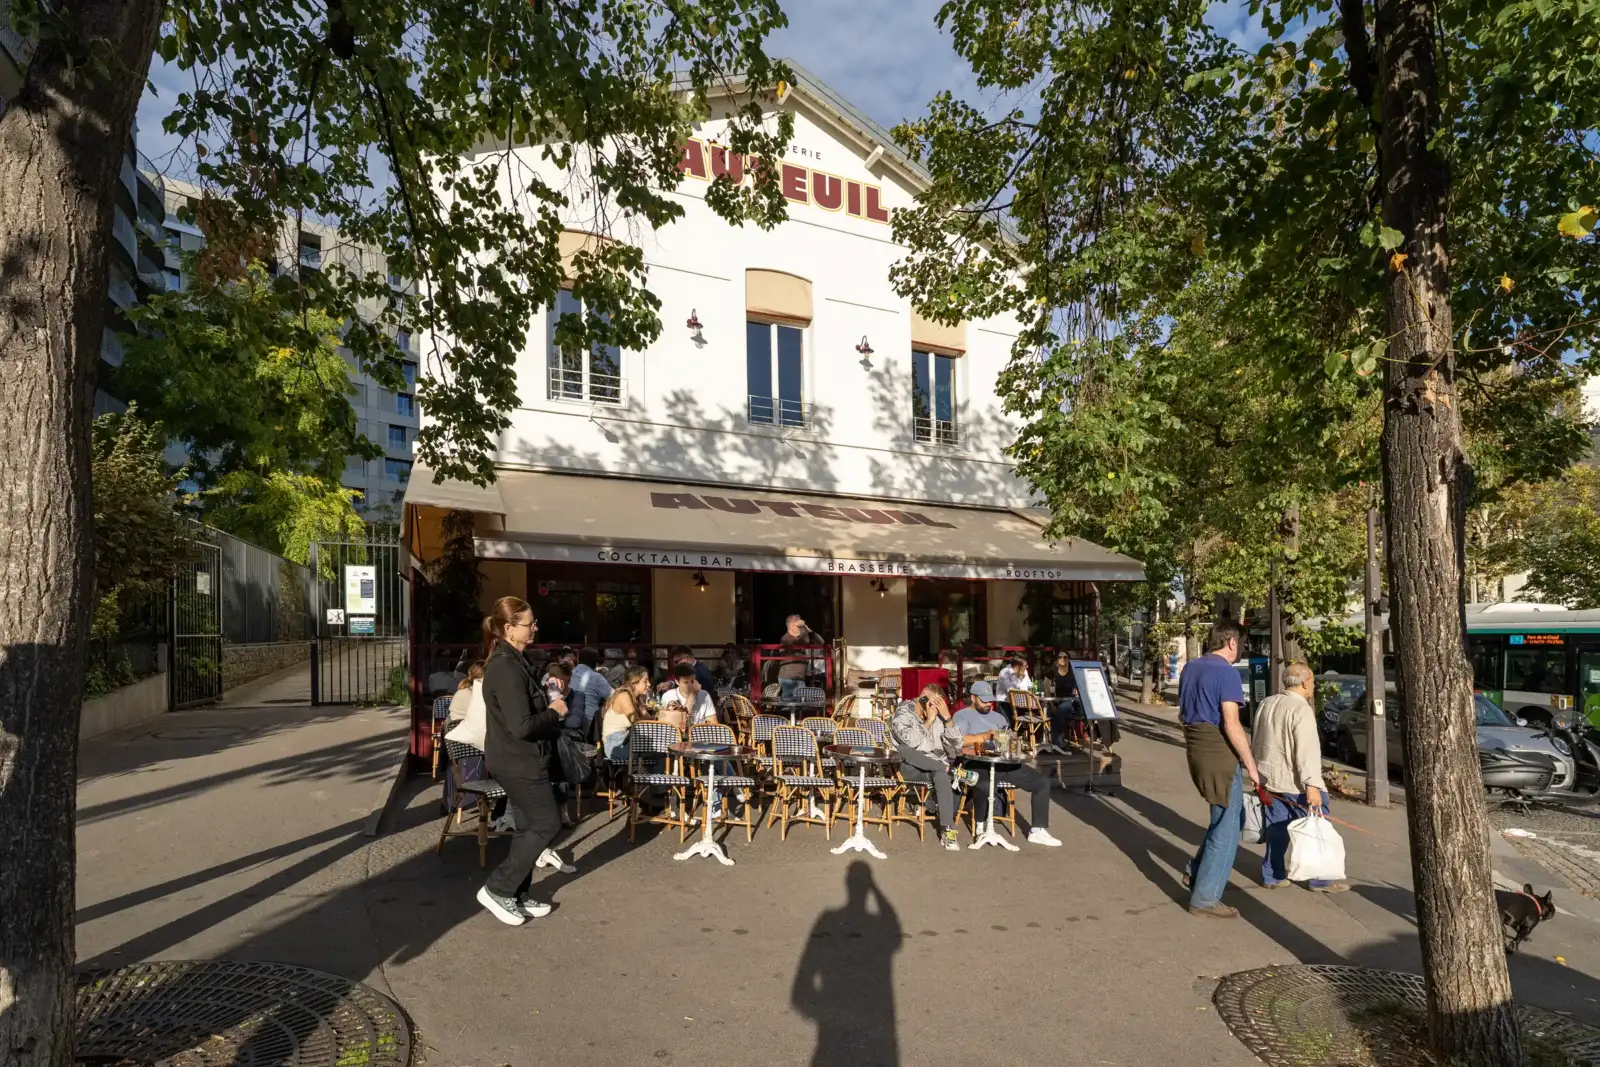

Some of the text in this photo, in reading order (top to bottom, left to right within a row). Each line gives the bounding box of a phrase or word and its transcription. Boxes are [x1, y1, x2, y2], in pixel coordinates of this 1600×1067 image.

[650, 492, 957, 529] AUTEUIL
[597, 551, 1062, 579] COCKTAIL BAR BRASSERIE ROOFTOP
